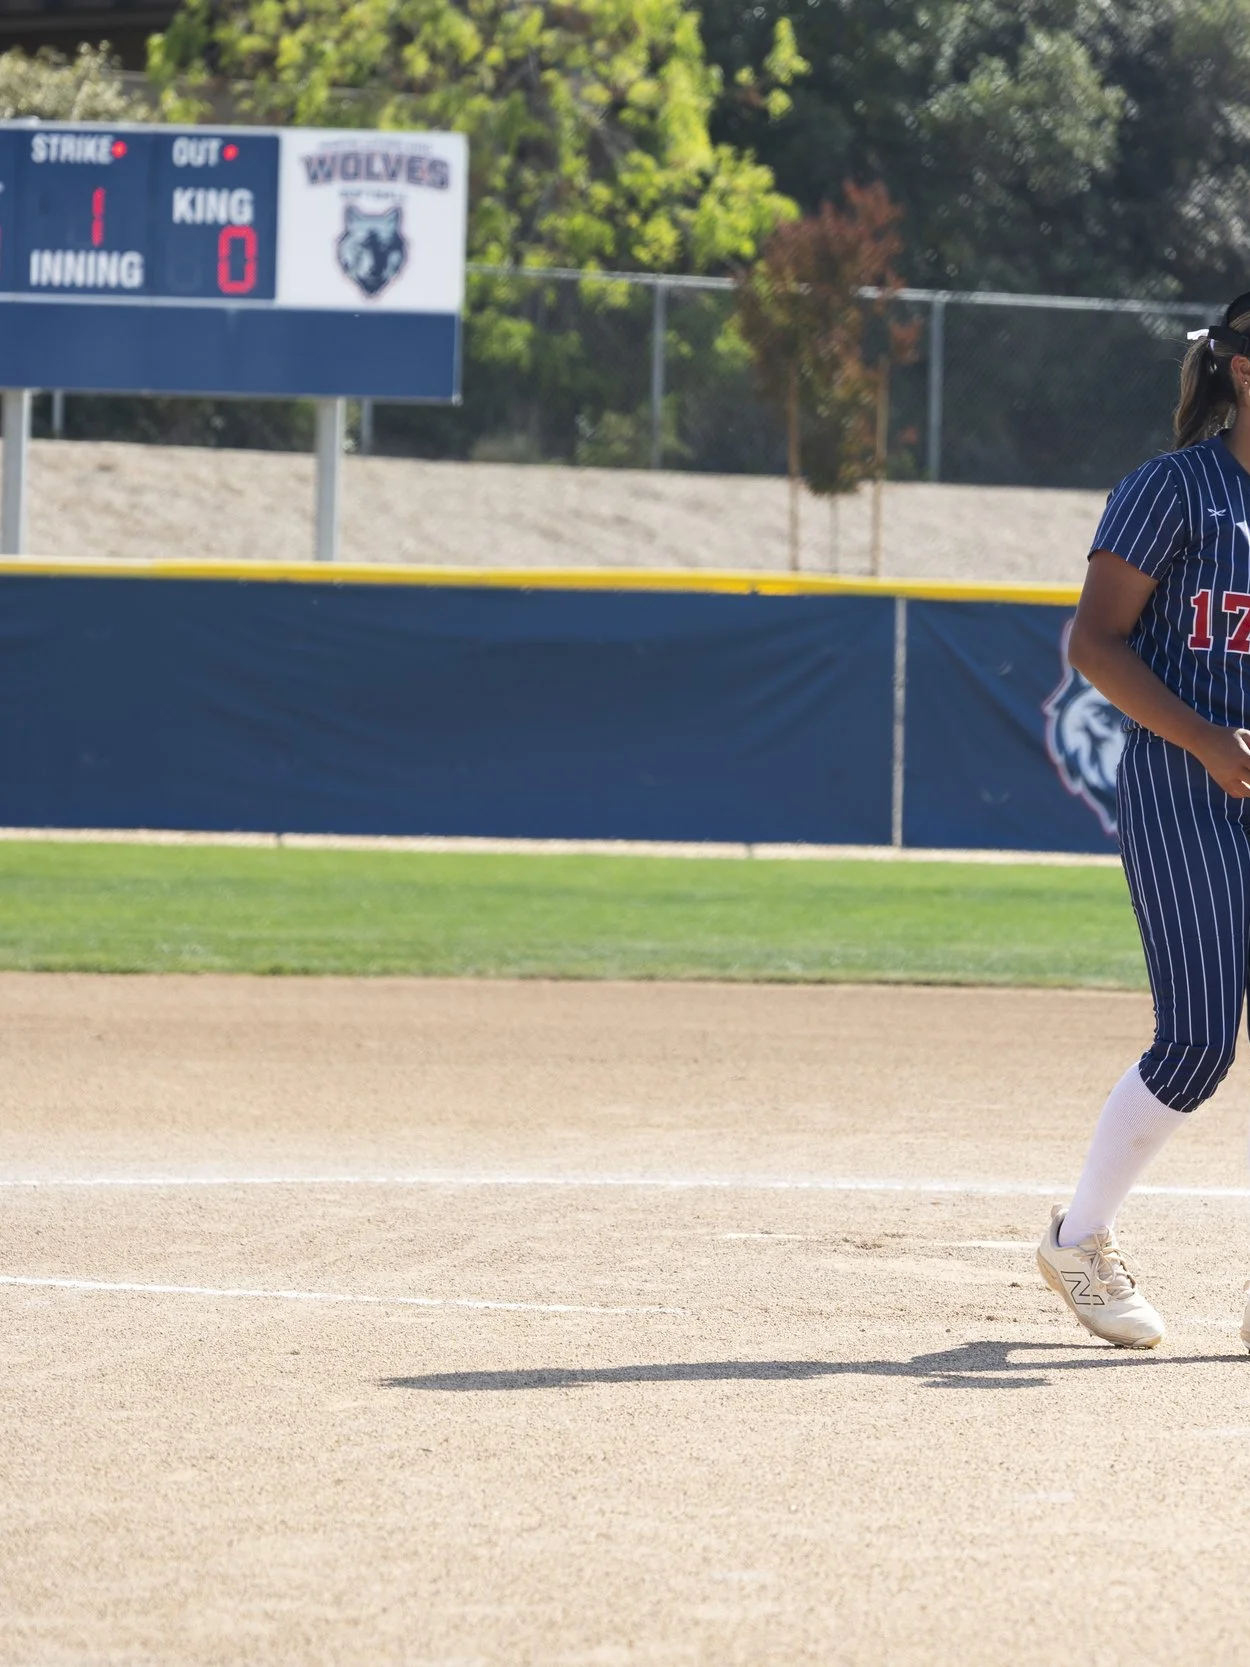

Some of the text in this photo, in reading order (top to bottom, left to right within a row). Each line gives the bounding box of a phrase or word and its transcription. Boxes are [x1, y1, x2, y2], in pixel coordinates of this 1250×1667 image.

[31, 133, 114, 164] STRIKE
[172, 137, 221, 167] OUT
[302, 152, 450, 189] WOLVES
[172, 187, 254, 225] KING
[30, 250, 144, 289] INNING
[217, 225, 257, 294] 0
